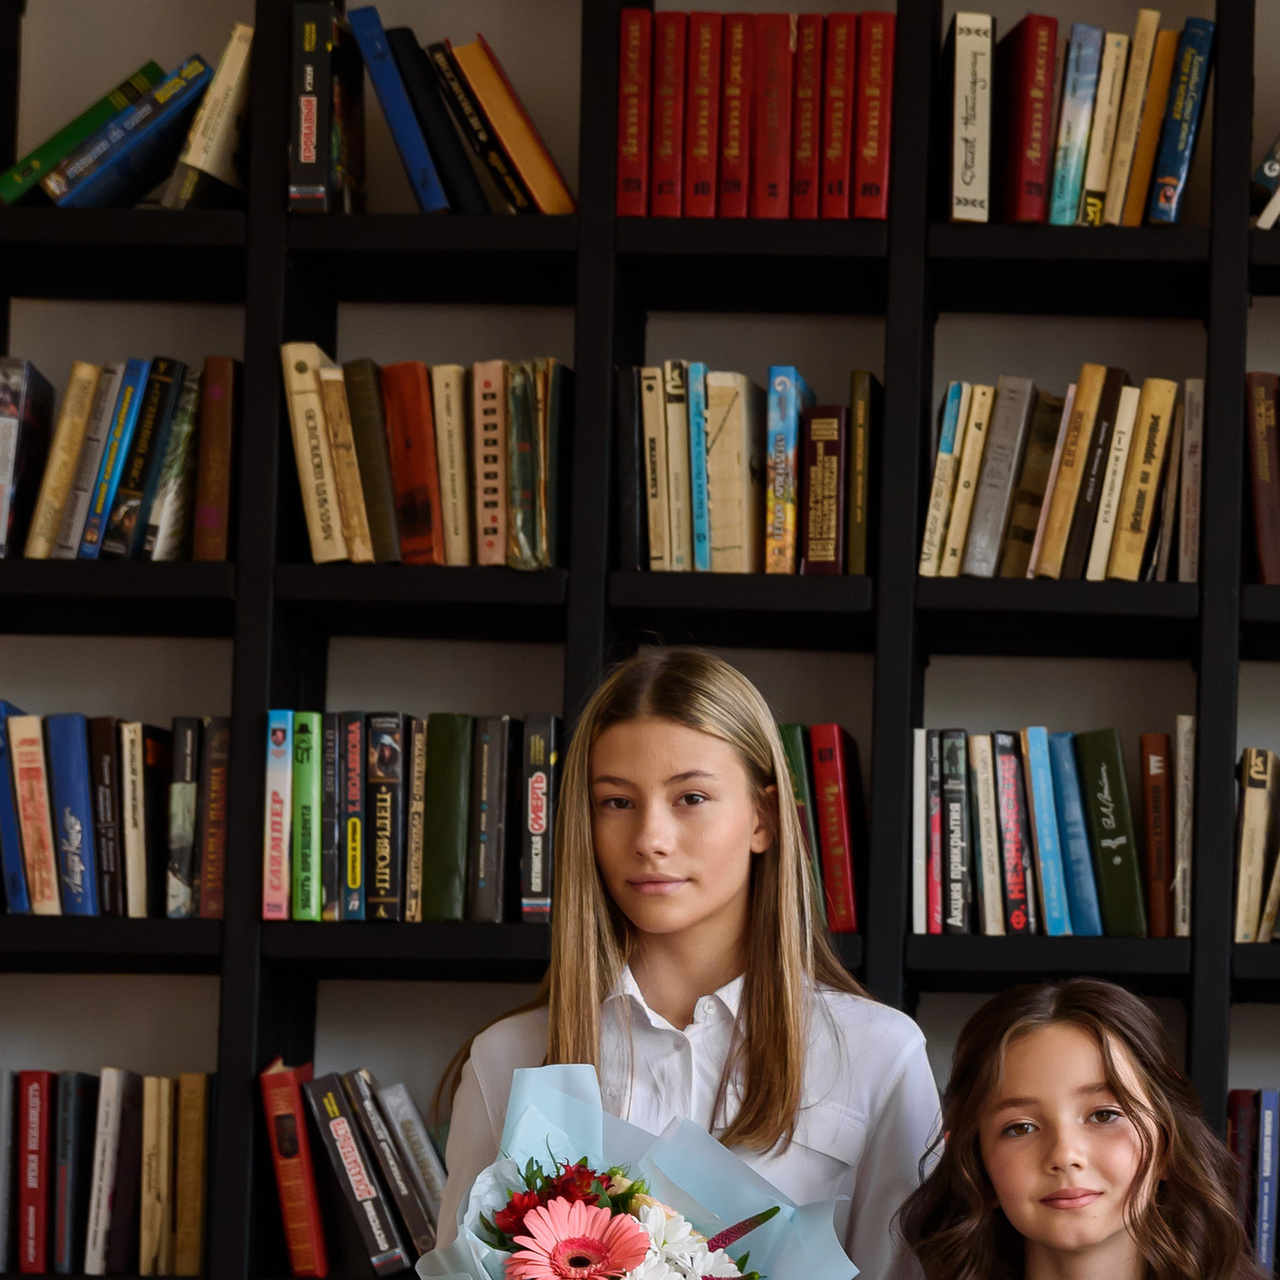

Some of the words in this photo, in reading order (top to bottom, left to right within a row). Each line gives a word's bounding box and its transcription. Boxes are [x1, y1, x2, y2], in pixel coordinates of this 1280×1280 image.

[528, 772, 546, 833] СМЕРТЬ
[999, 754, 1025, 900] НЕЗНАНСКИЙ
[949, 802, 966, 880] прикрытия
[946, 883, 963, 927] Акция
[1009, 904, 1026, 930] Ф.
